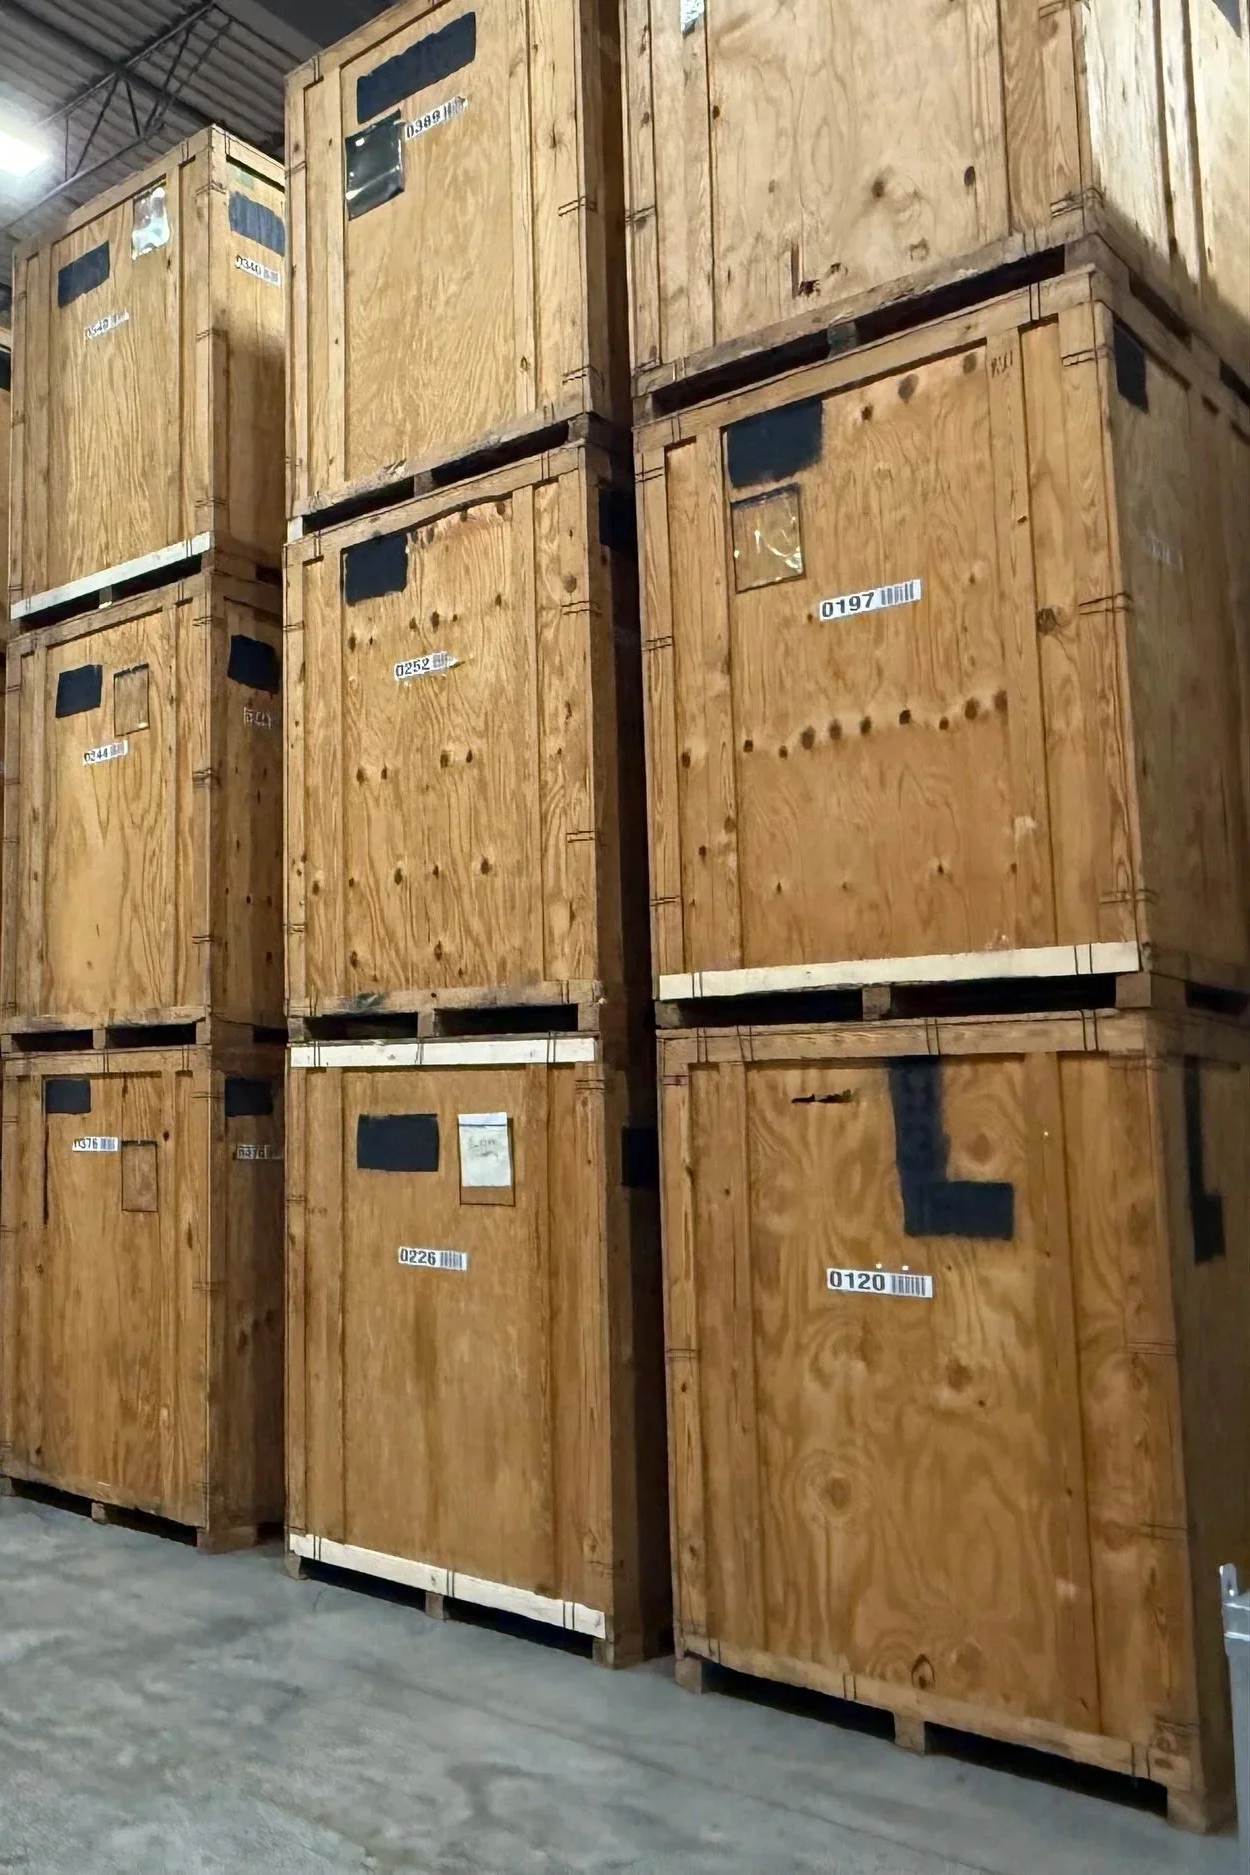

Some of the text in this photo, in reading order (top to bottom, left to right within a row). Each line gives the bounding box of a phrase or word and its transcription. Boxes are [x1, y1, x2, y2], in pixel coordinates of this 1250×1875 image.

[821, 592, 875, 618] 0197
[395, 657, 431, 677] 0252
[400, 1248, 436, 1266] 0226
[829, 1270, 886, 1292] 0120
